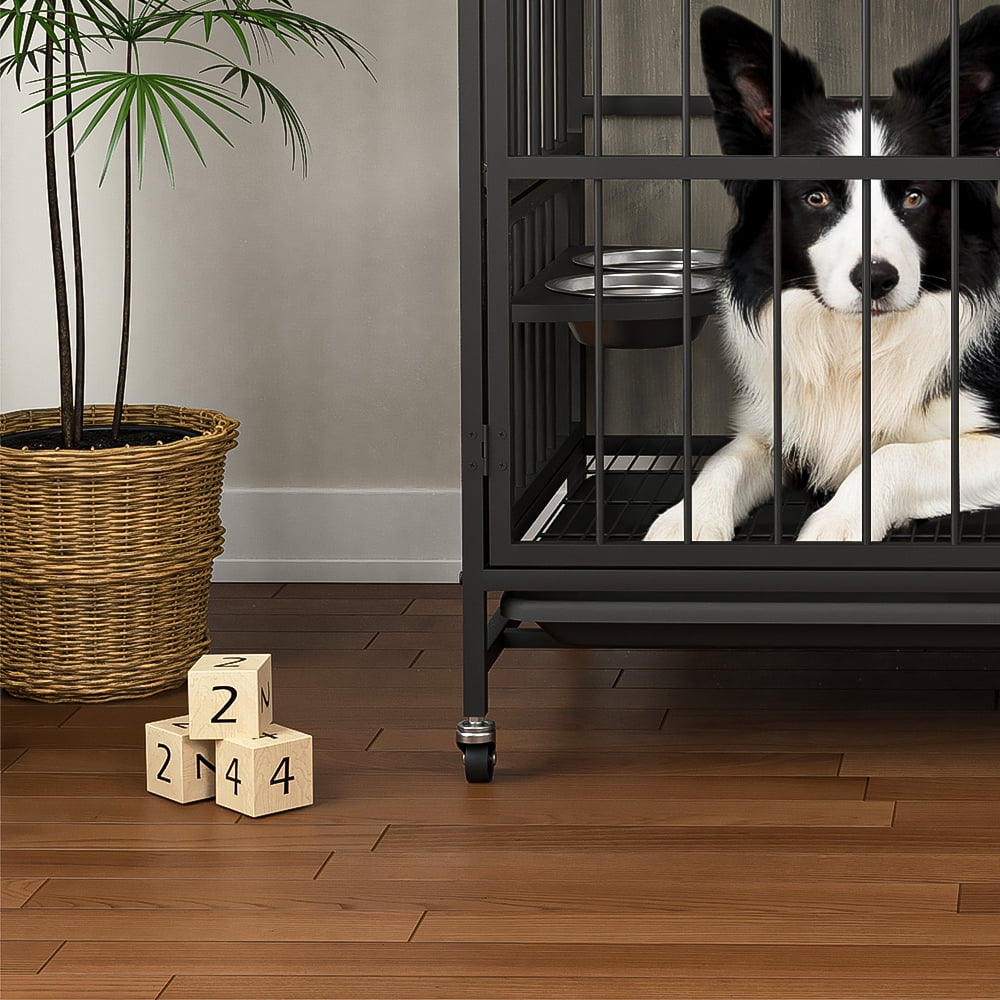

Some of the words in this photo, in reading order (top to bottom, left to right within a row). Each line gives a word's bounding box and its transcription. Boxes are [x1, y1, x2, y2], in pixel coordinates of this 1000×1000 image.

[210, 685, 238, 724] 2
[156, 743, 171, 783] 2
[225, 757, 242, 796] 4
[269, 756, 295, 795] 4
